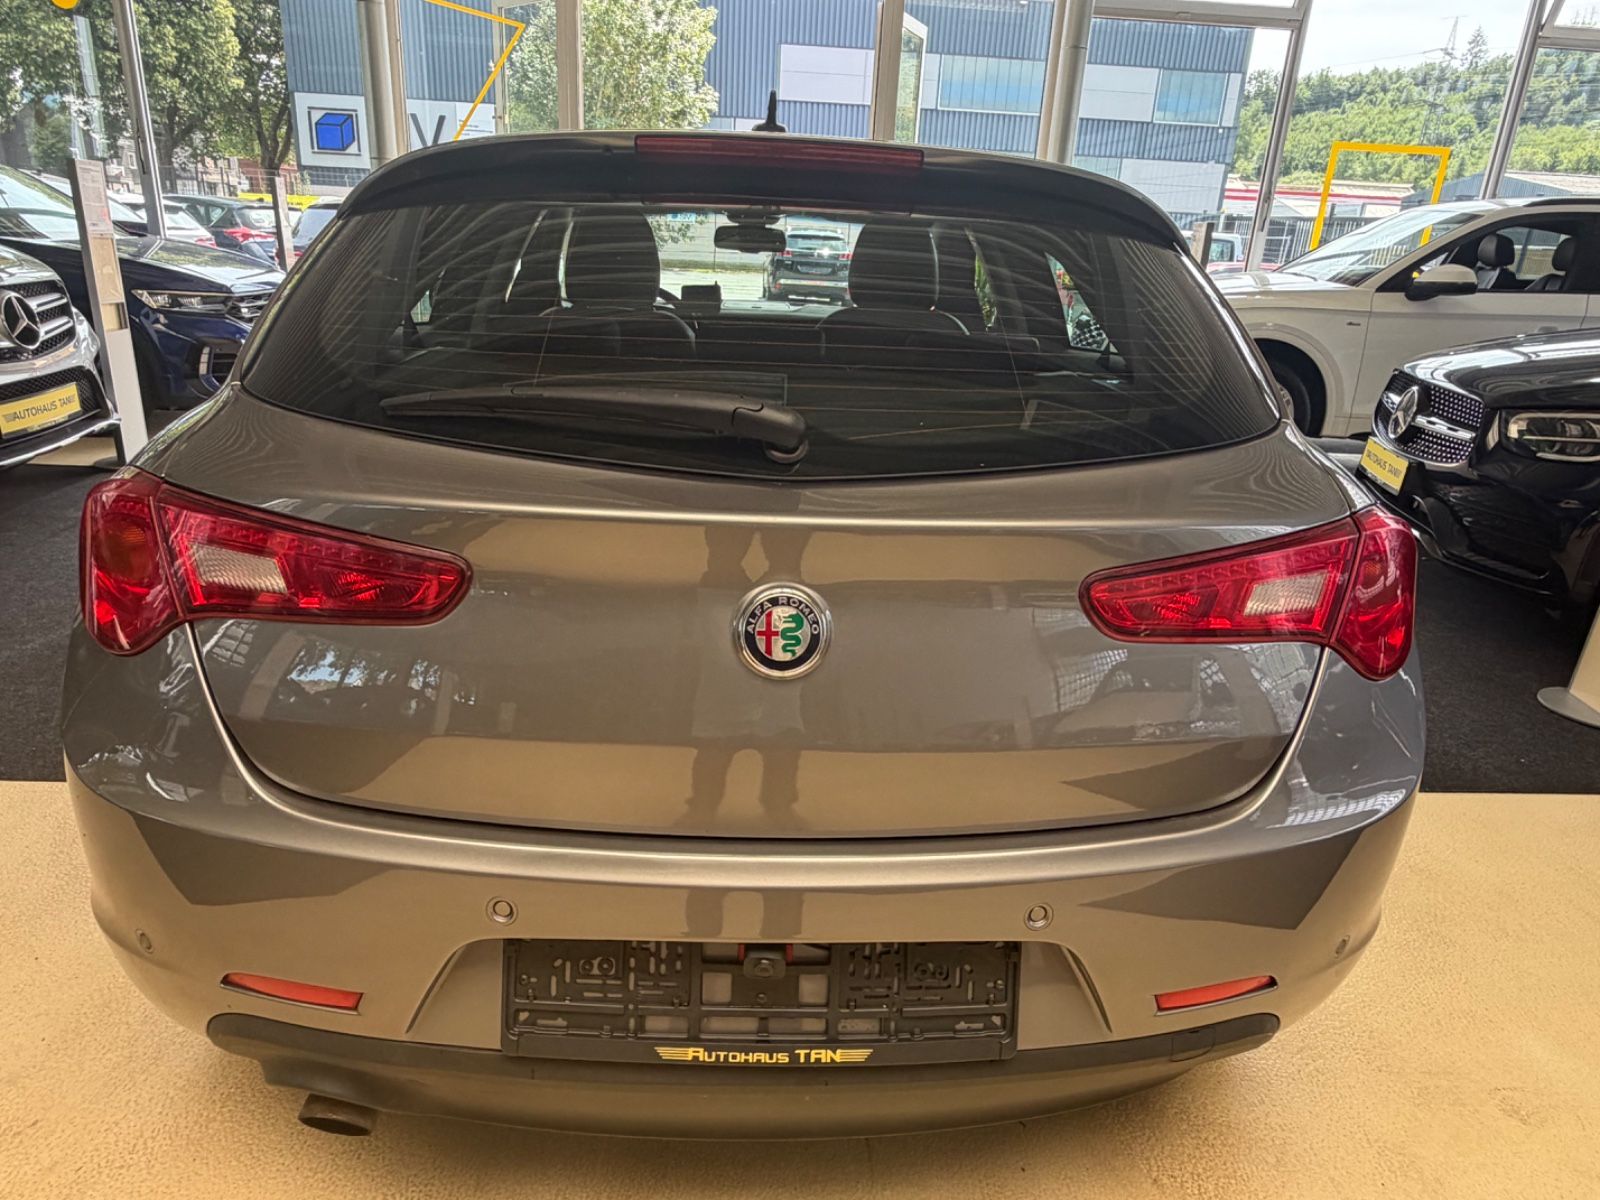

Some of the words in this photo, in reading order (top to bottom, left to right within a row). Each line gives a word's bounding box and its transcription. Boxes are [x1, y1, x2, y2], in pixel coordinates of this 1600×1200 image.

[13, 401, 58, 420] AUTOHAUS
[746, 600, 772, 634] ALFA
[778, 596, 820, 635] ROMEO
[795, 1049, 841, 1063] TAN
